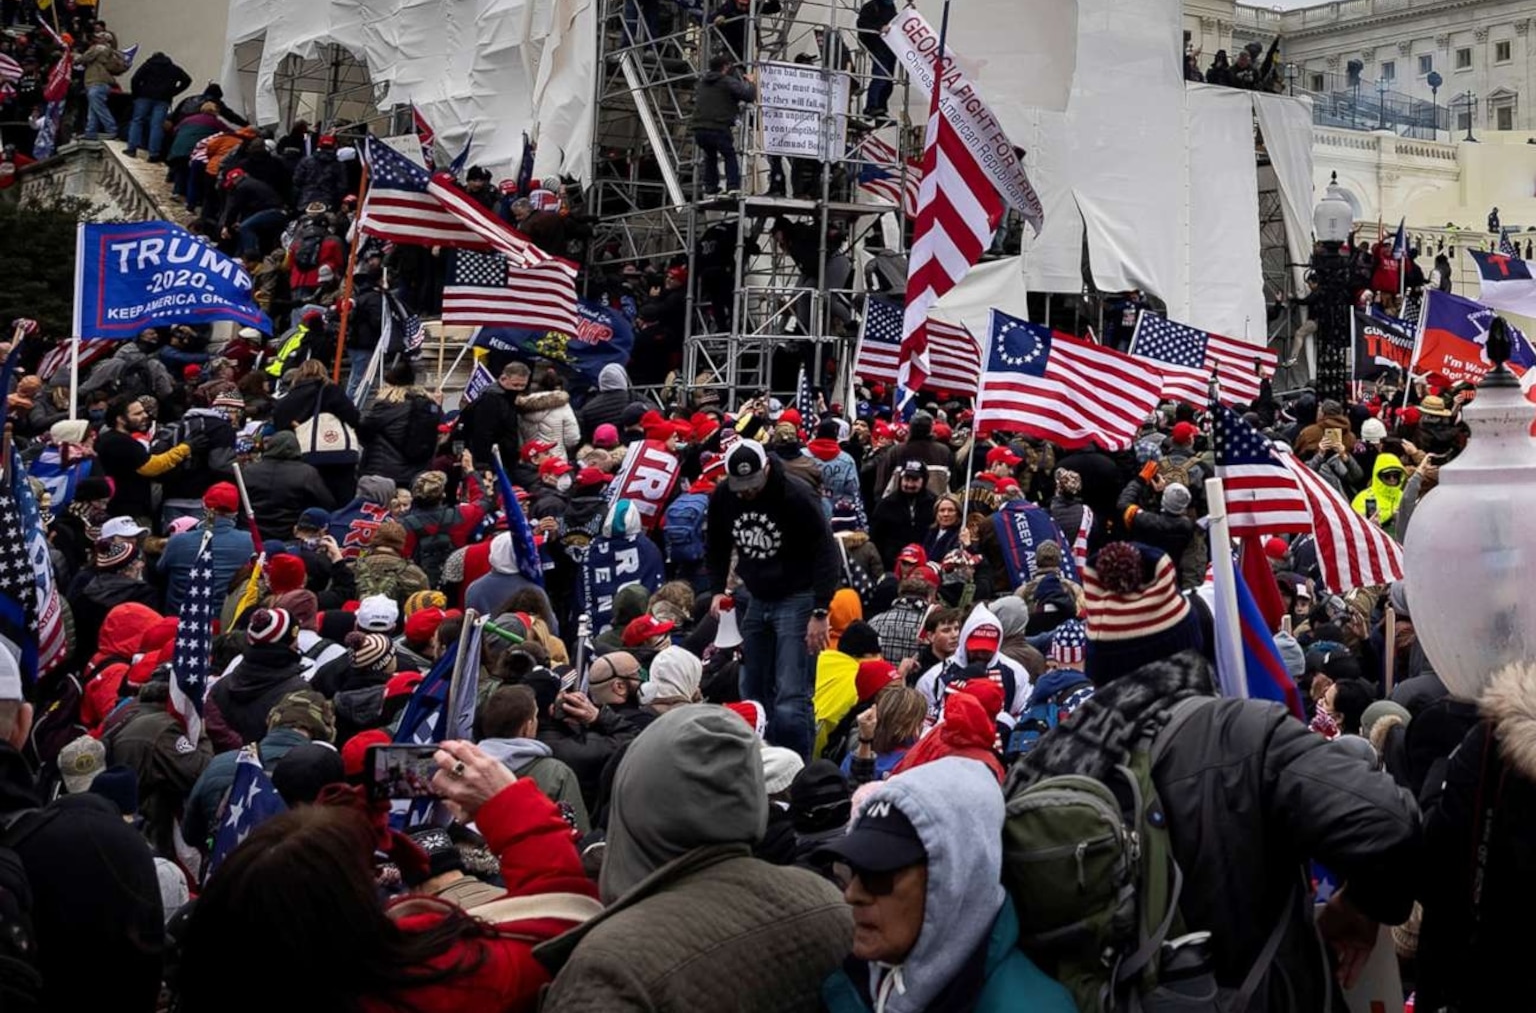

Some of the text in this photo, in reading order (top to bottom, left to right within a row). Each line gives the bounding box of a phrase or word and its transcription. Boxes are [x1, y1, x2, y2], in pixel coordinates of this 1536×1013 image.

[955, 84, 996, 144] FIGHT
[990, 131, 1016, 167] FOR
[938, 97, 978, 150] American
[976, 144, 1027, 211] Republicans
[111, 238, 253, 291] TRUMP
[107, 305, 145, 320] KEEP
[143, 293, 197, 314] AMERICA
[1013, 511, 1035, 548] KEEP
